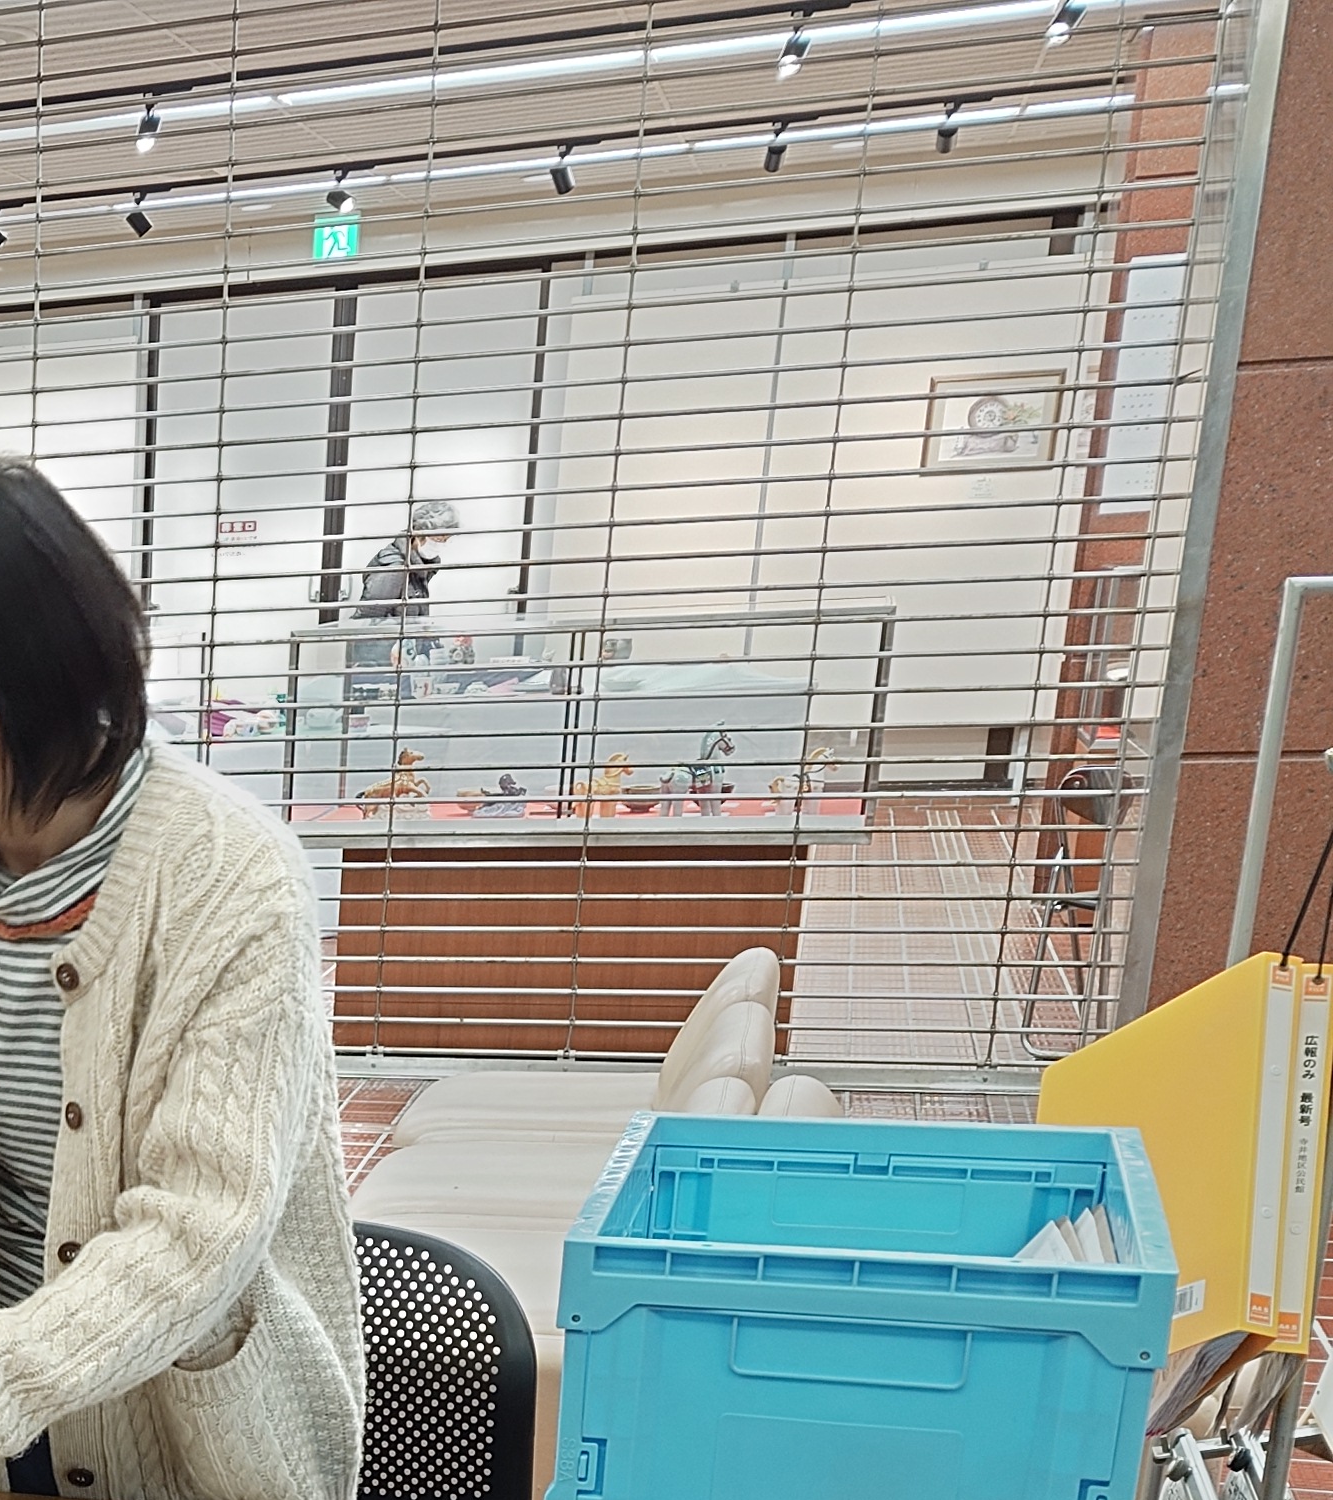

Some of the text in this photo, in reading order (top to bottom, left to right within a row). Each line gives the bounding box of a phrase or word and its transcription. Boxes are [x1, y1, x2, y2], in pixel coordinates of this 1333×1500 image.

[1294, 1035, 1320, 1194] 広報のみ 最新号 寺井地区公民館
